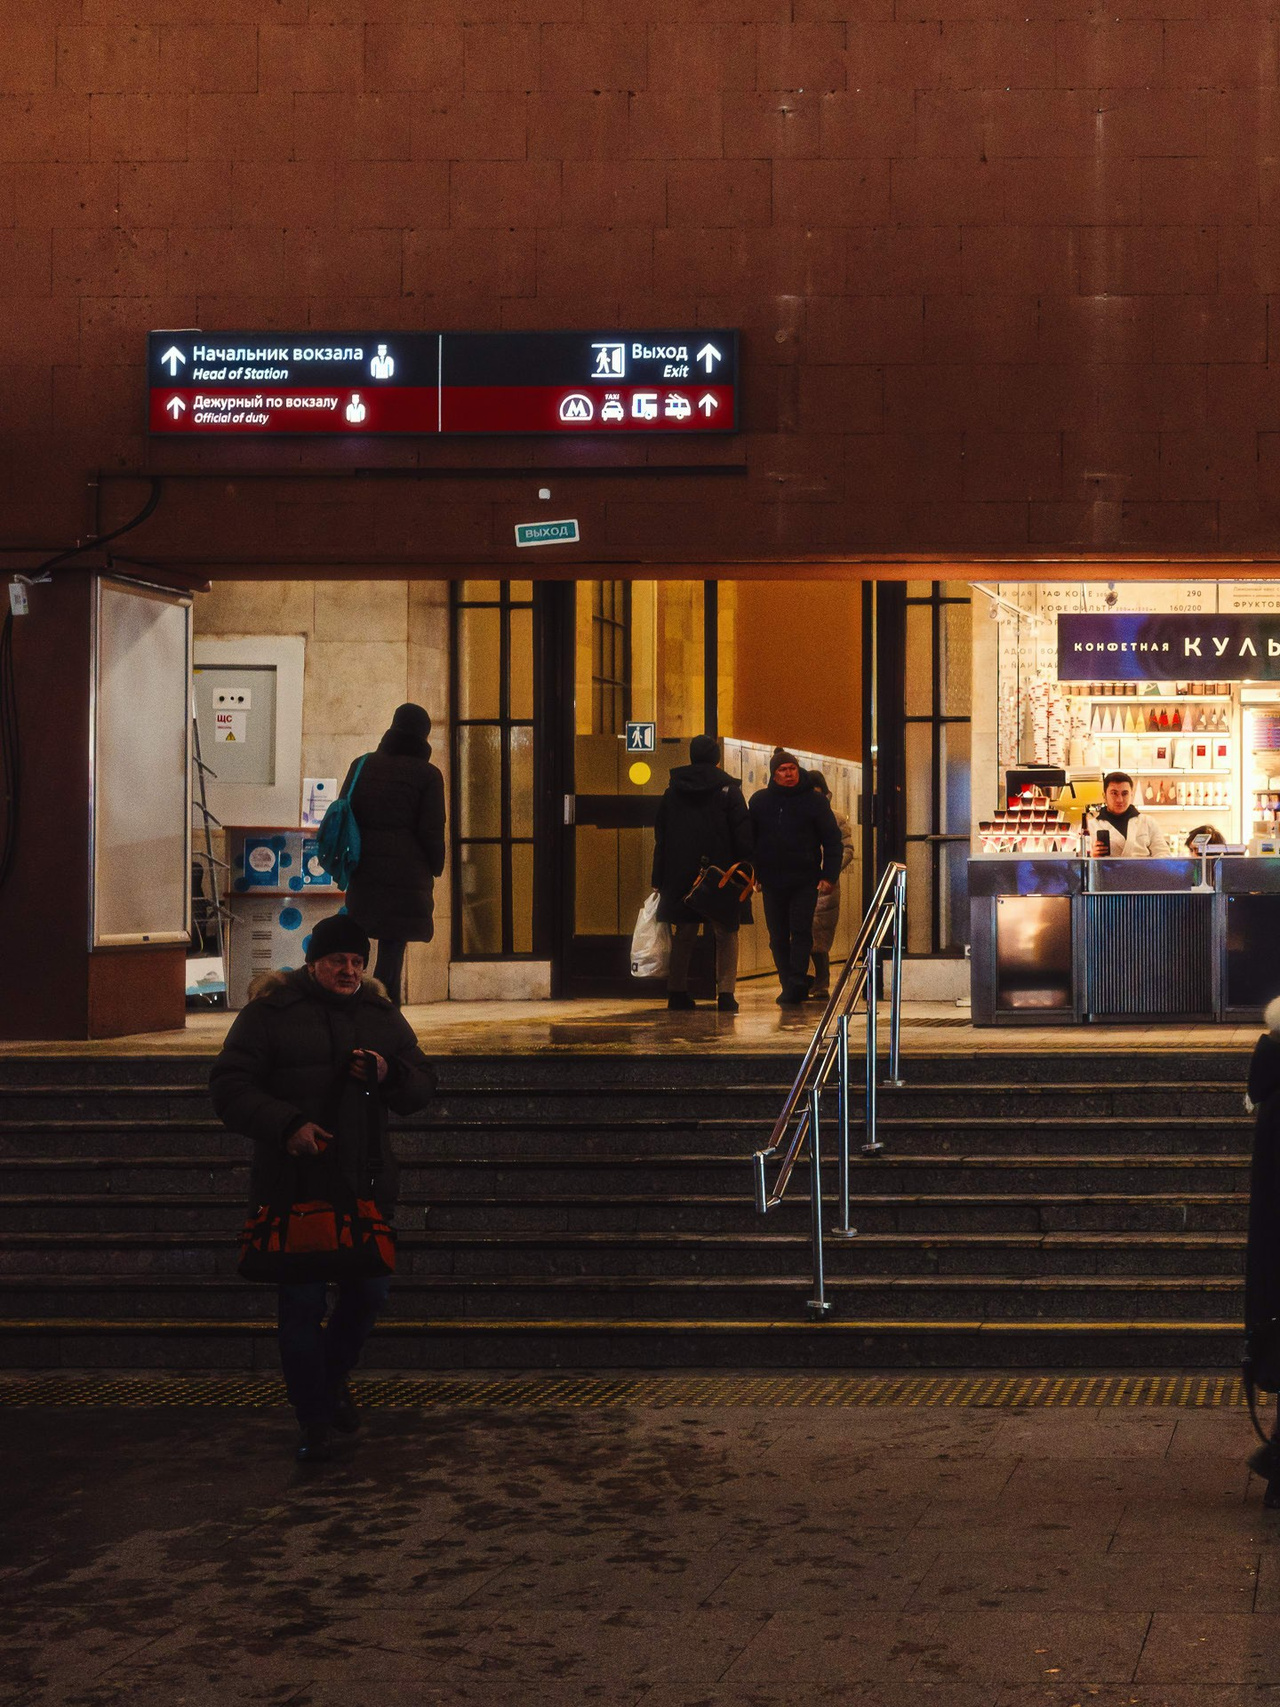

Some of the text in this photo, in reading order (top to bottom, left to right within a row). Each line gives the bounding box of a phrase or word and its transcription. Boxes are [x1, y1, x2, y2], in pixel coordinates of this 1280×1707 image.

[193, 345, 364, 361] Начальник вокзала
[632, 343, 689, 361] Выход
[193, 367, 289, 380] Head of Station
[663, 365, 690, 378] Exit
[193, 395, 339, 411] Дежурный по вокзалу
[194, 412, 270, 425] Official of duty
[525, 526, 569, 539] ВЫХОД
[1169, 604, 1202, 612] 160/200
[1074, 642, 1169, 652] КОНФЕТНАЯ
[217, 714, 233, 724] ЩС
